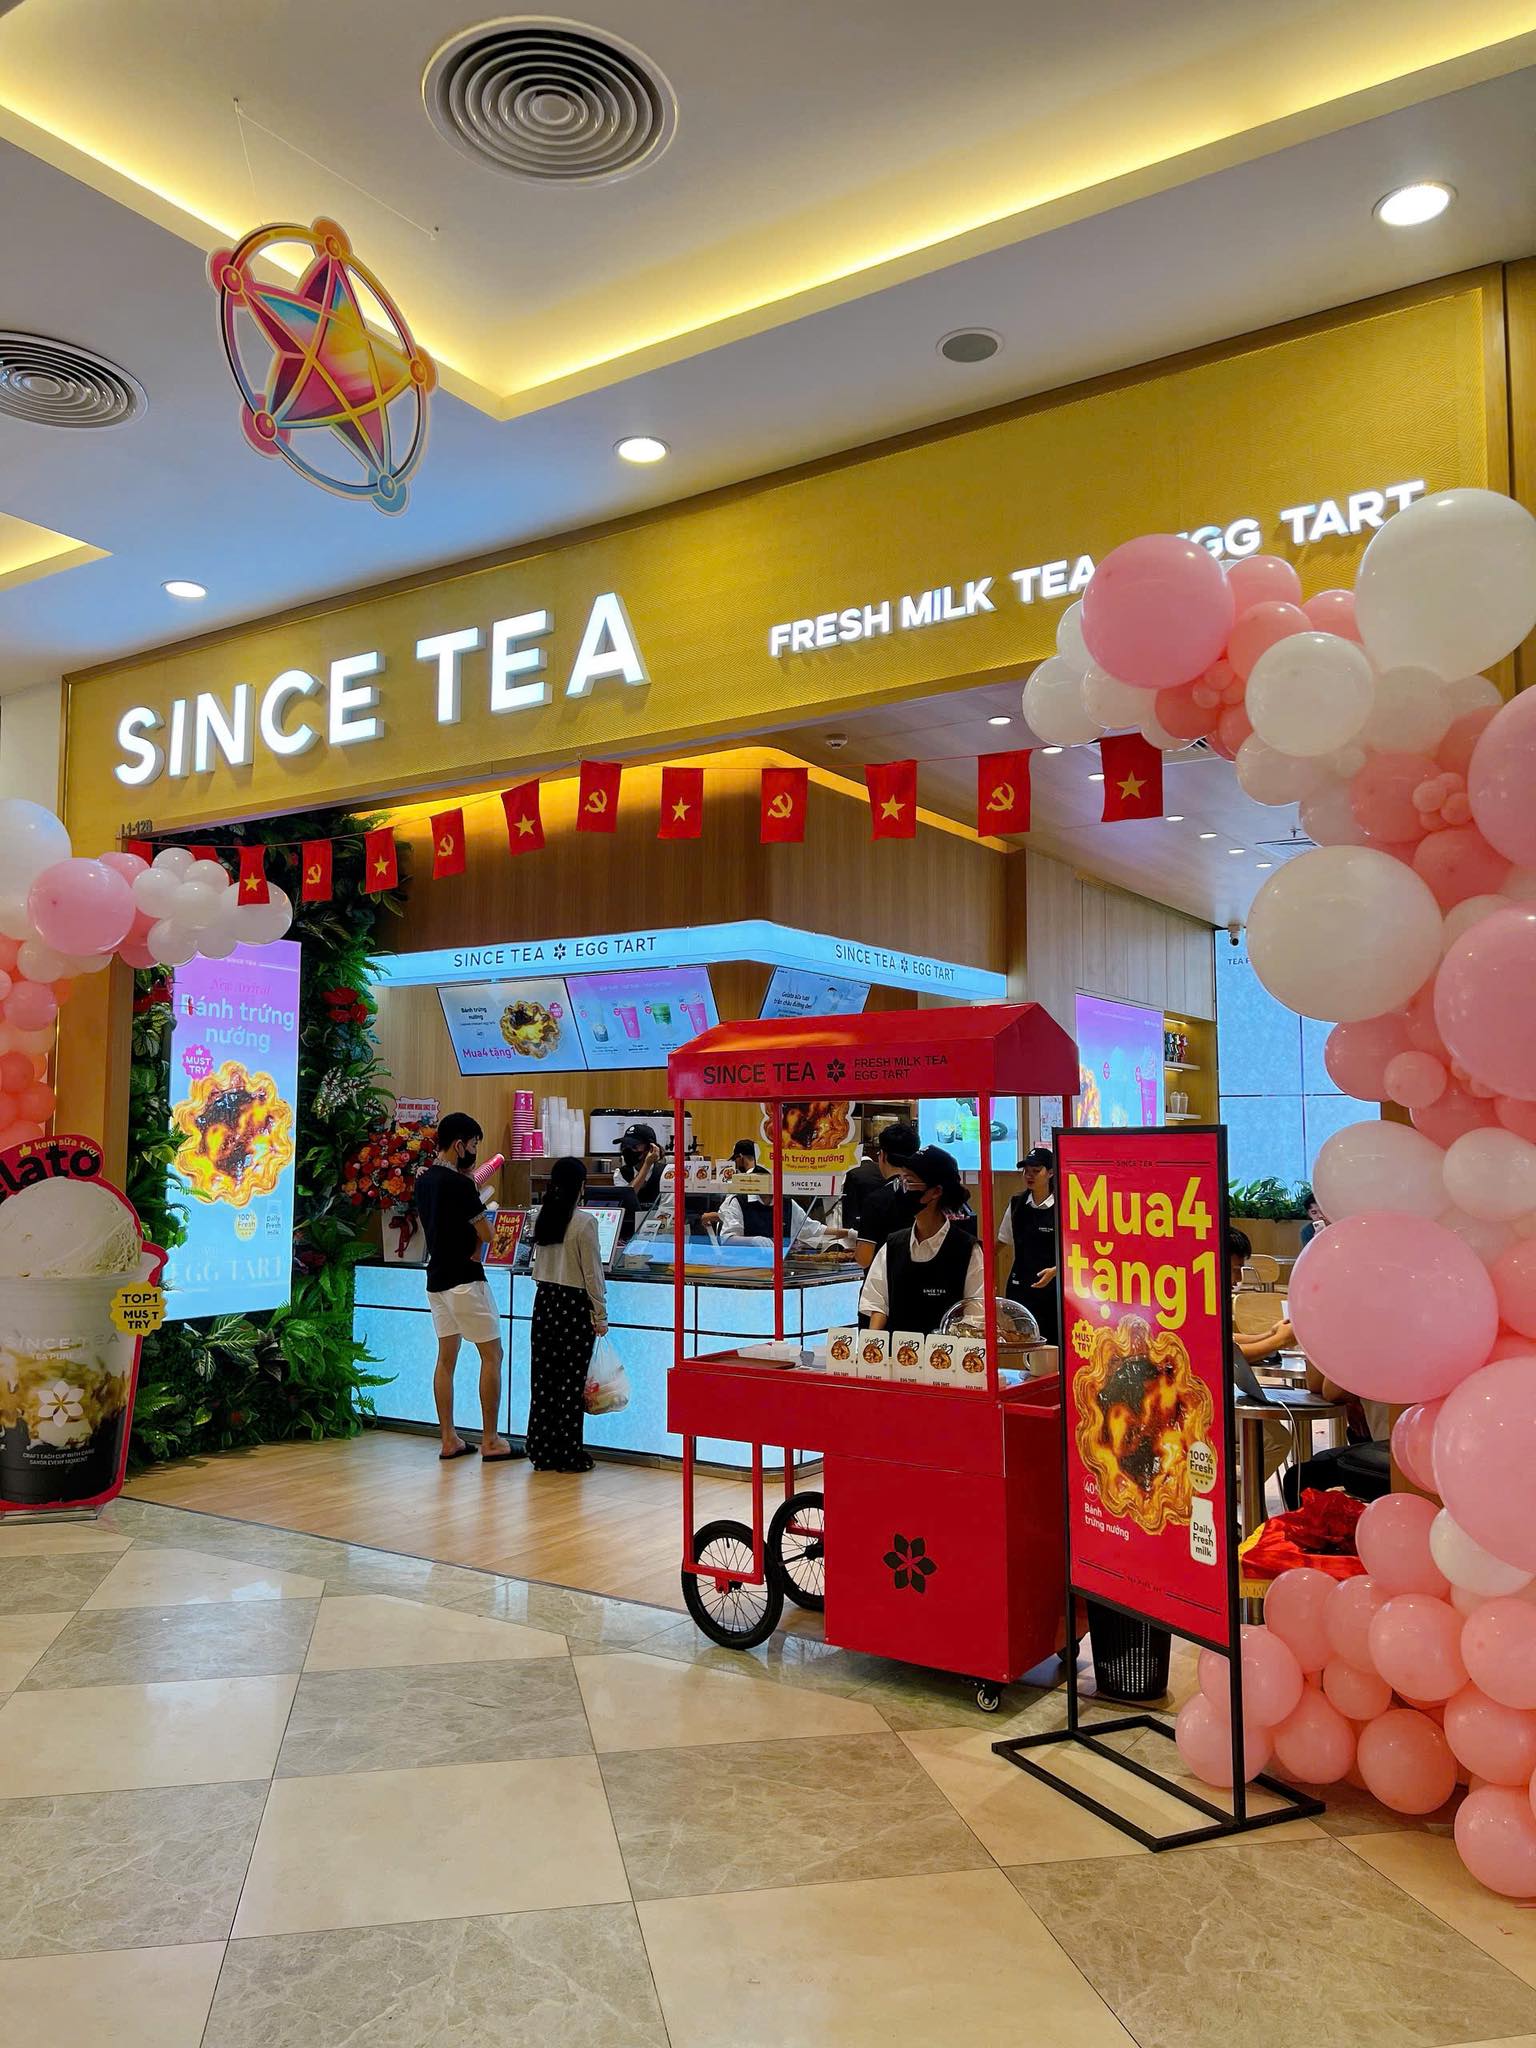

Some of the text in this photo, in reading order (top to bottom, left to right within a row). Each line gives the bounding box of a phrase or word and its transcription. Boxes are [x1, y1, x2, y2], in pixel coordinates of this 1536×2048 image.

[1176, 479, 1426, 557] GG TART
[769, 554, 1097, 658] FRESH MILK TEA
[114, 592, 650, 786] SINCE TEA
[454, 937, 657, 968] SINCE TEA EGG TART
[835, 944, 955, 981] SINCE TEA EGG TART
[181, 994, 295, 1031] Bánh trứng
[205, 1026, 271, 1054] nướng
[185, 1056, 212, 1065] MUST
[854, 1055, 948, 1068] FRESH MILK TEA
[188, 1065, 207, 1075] TRY
[703, 1062, 816, 1085] SINCE TEA
[854, 1068, 910, 1081] EGG TART
[34, 1140, 56, 1150] kem
[791, 1153, 815, 1165] trứng
[818, 1153, 845, 1164] nướng
[0, 1146, 99, 1201] lato
[121, 1293, 158, 1304] TOP1
[128, 1320, 151, 1330] TRY
[1074, 1333, 1094, 1342] MUST
[1077, 1342, 1092, 1352] TRY
[1190, 1450, 1214, 1464] 100%
[1190, 1460, 1214, 1475] Fresh
[1084, 1502, 1103, 1517] Bánh
[1085, 1515, 1130, 1541] trứng nướng
[1193, 1521, 1213, 1537] Daily
[1192, 1533, 1214, 1547] Fresh
[1195, 1545, 1212, 1558] milk
